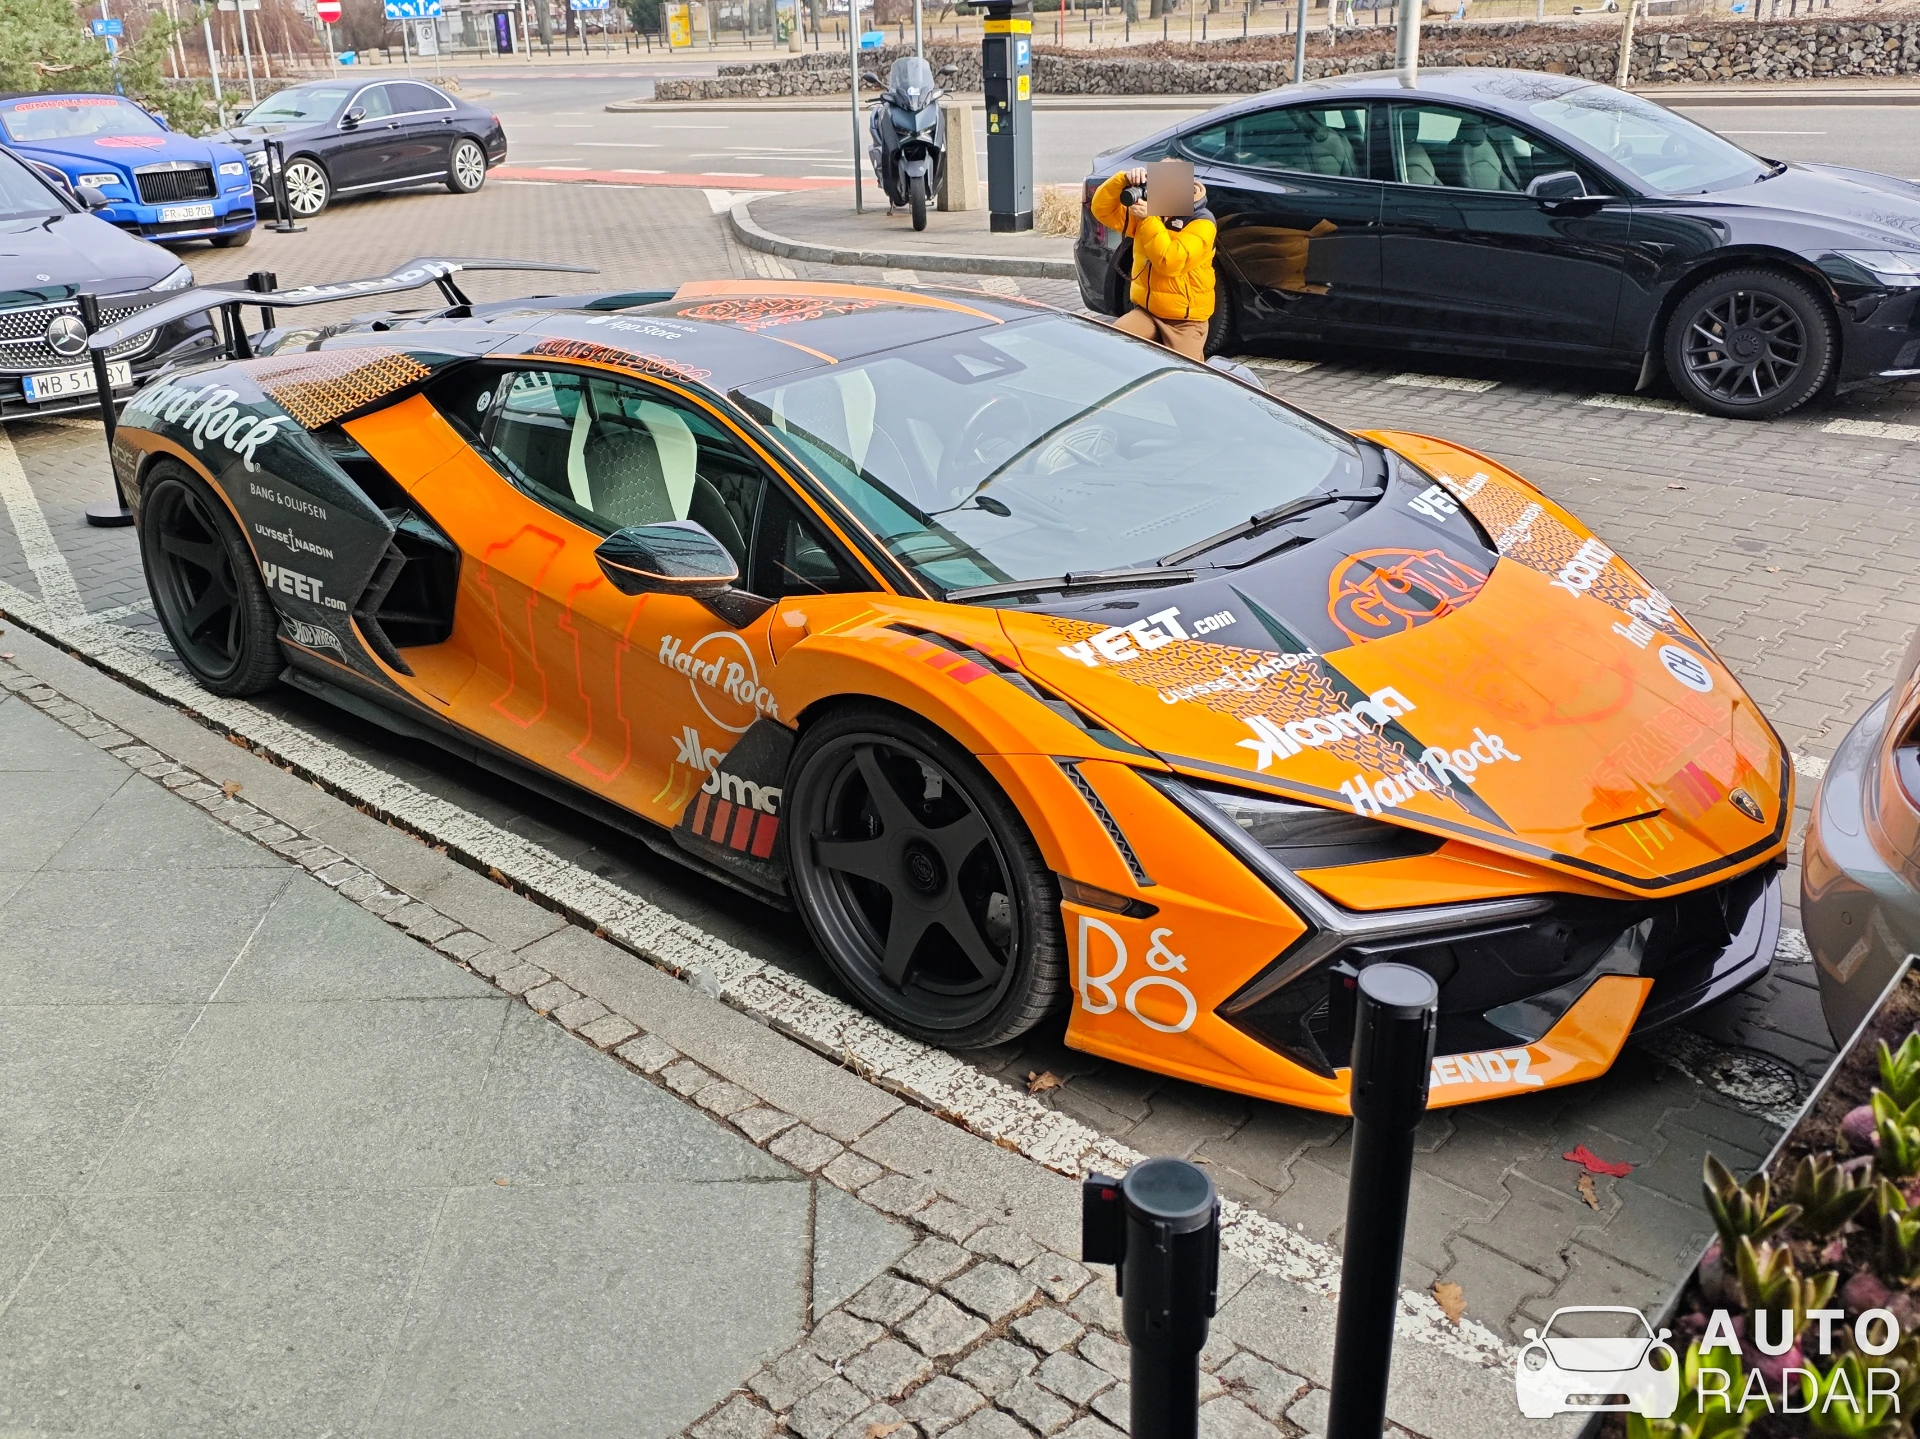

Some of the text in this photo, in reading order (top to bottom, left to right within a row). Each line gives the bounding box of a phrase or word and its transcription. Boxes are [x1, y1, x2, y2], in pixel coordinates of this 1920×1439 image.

[604, 320, 682, 340] App Store
[37, 365, 125, 394] WB 51BY
[183, 388, 291, 473] Rock
[250, 482, 327, 521] BANG & OLUFSEN
[254, 523, 334, 560] ULYSSE NARDIN
[658, 634, 779, 719] Hard Rock
[1157, 647, 1320, 705] ULYSSE NARDIN
[1339, 727, 1521, 817] Hard Rock
